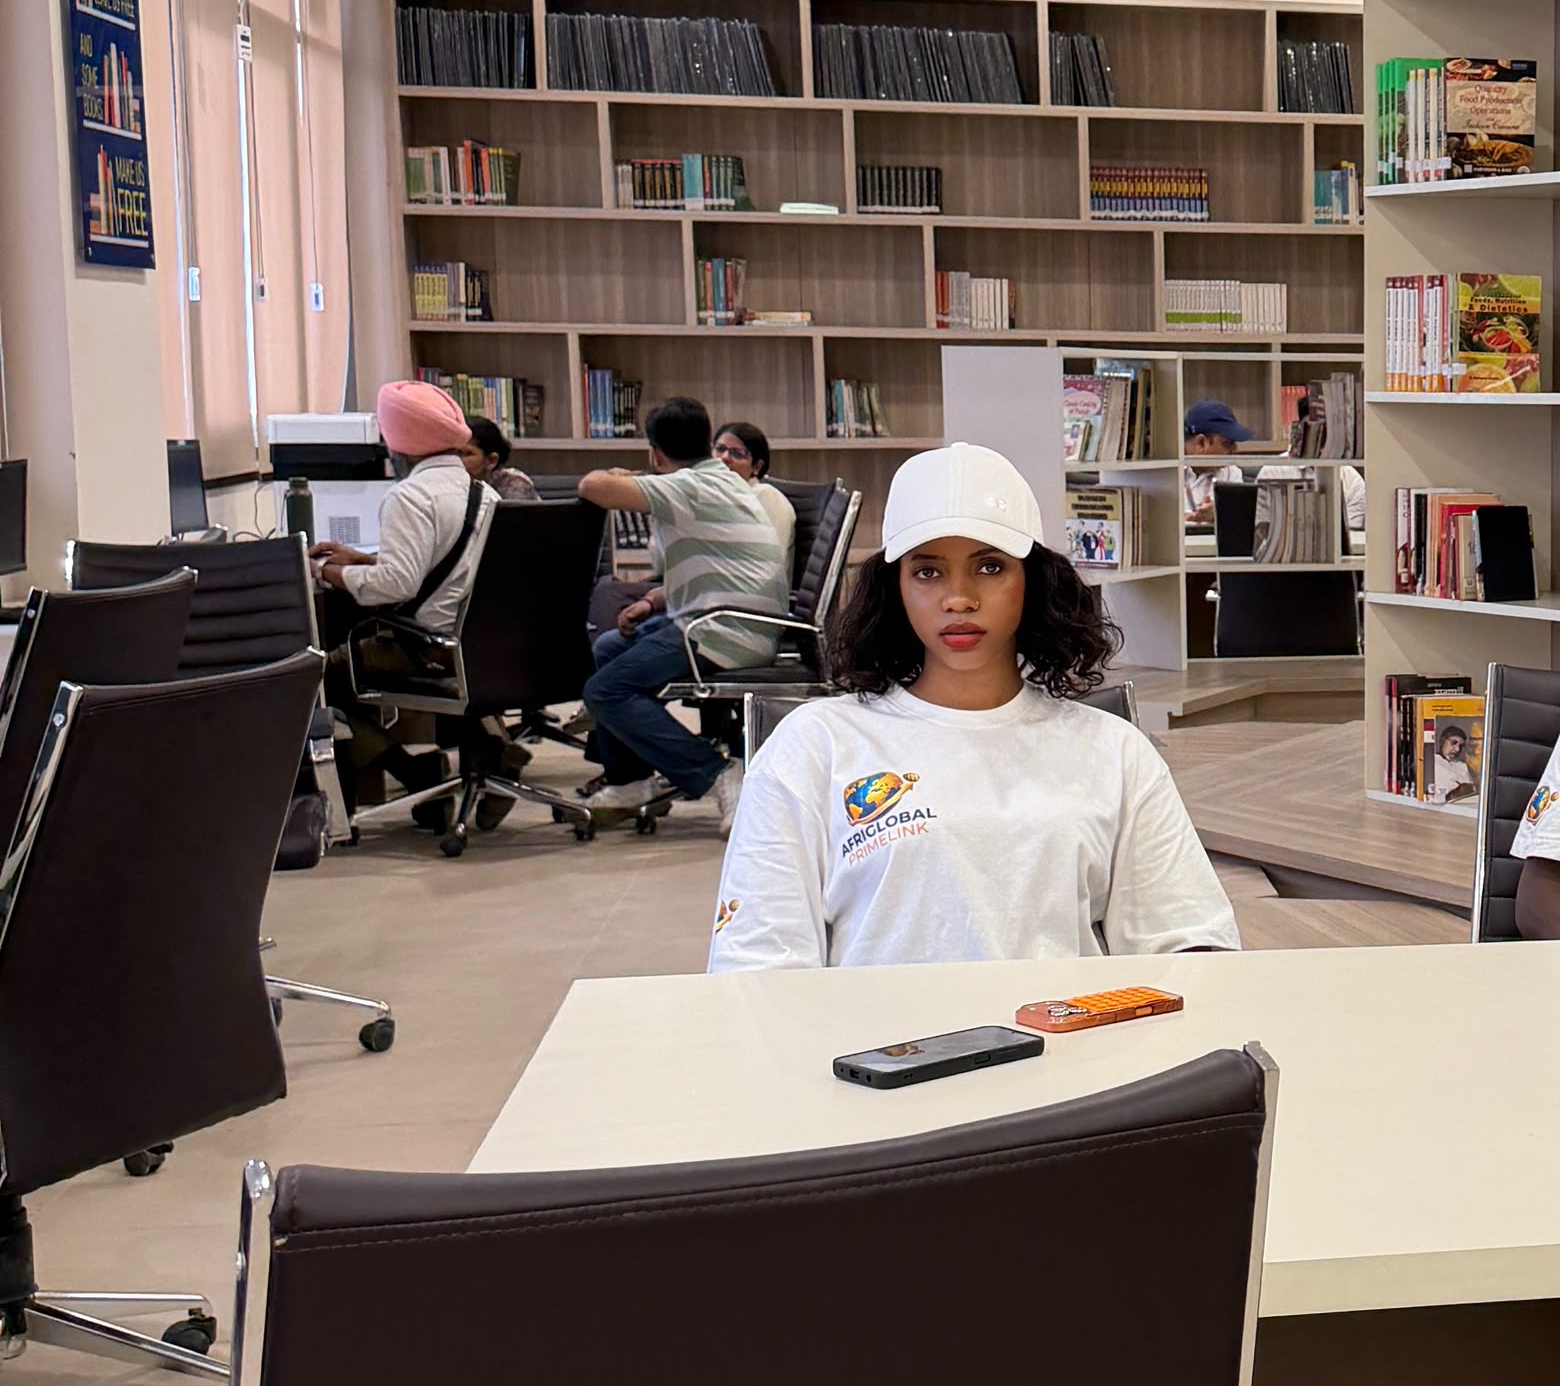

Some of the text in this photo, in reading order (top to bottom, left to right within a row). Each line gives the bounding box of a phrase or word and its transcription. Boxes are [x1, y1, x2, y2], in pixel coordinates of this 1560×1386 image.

[80, 32, 93, 57] AND
[81, 63, 98, 89] SOME
[83, 93, 103, 120] BOOKS
[115, 156, 146, 187] MAKE US
[117, 188, 149, 236] FREE
[1480, 304, 1528, 313] Dietetics
[841, 807, 938, 858] AFRIGLOBAL
[848, 821, 929, 867] PRIMELINK
